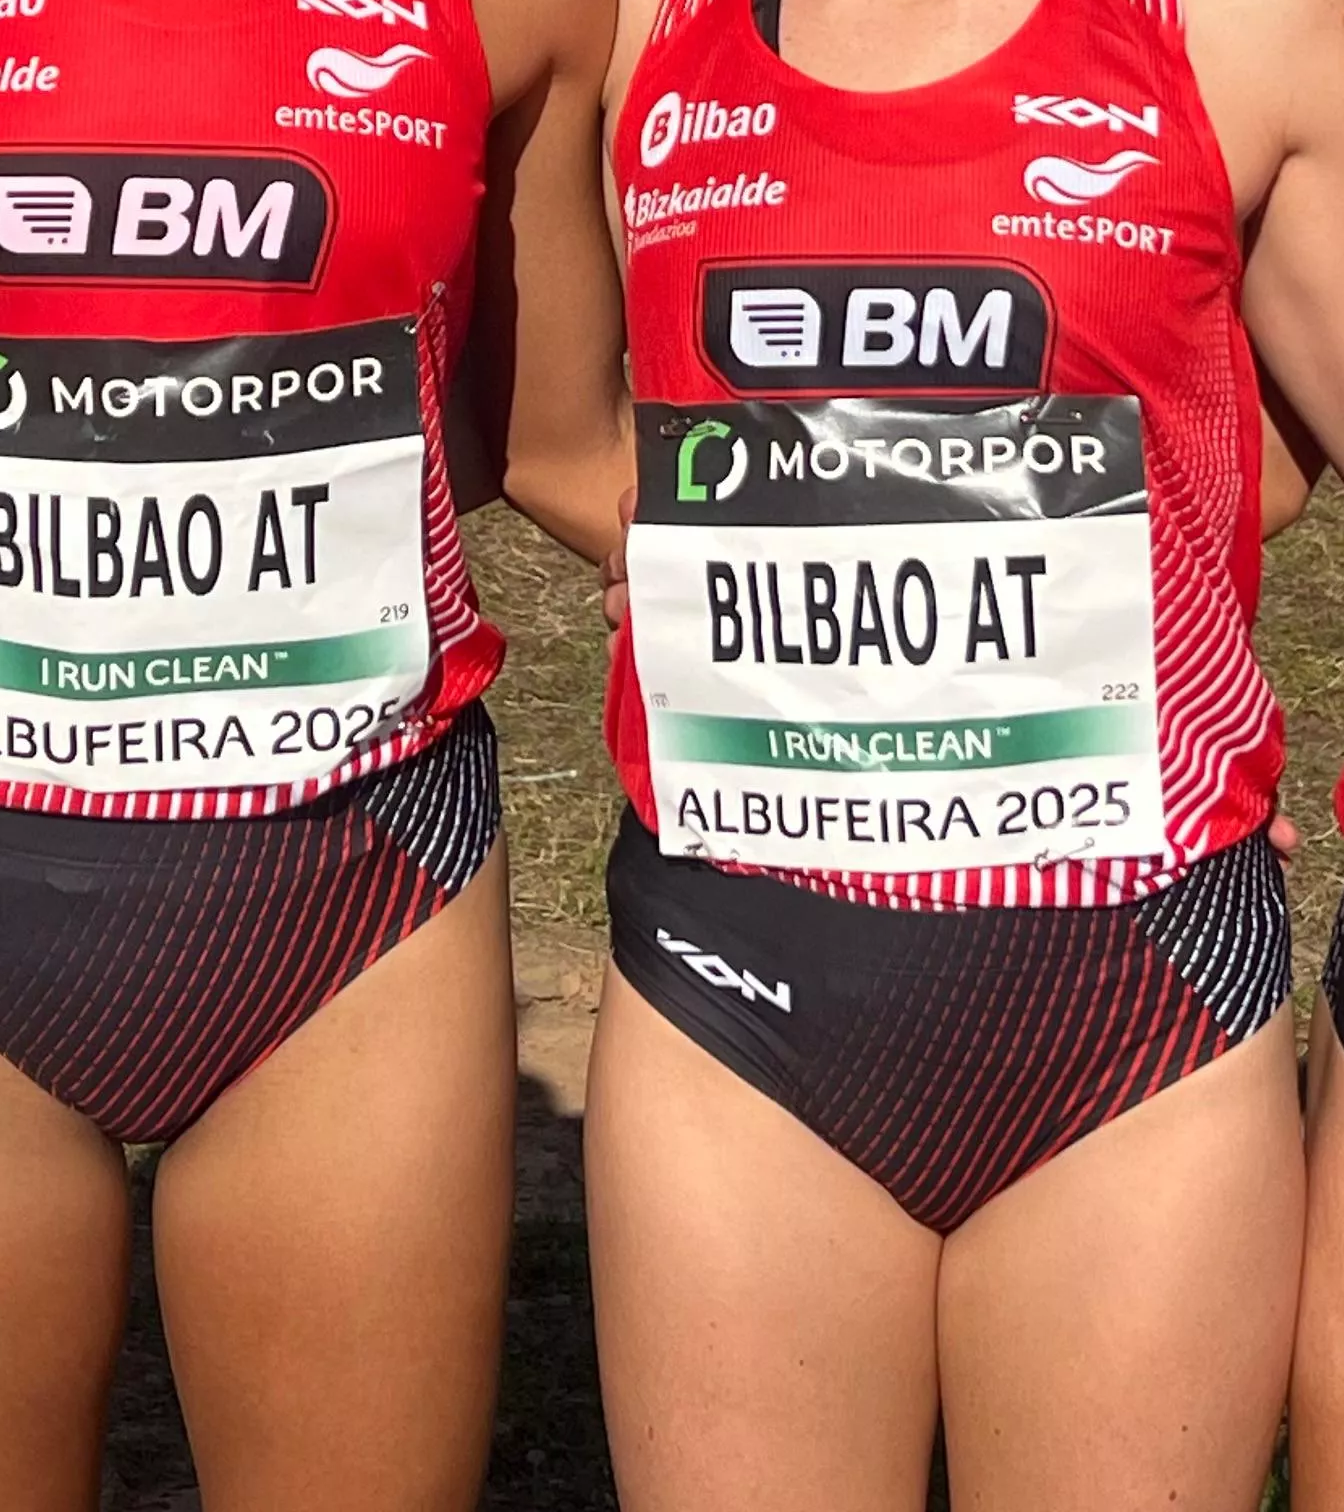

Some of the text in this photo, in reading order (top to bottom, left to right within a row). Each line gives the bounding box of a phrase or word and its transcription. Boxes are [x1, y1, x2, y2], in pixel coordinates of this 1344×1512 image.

[275, 104, 448, 150] emteSPORT
[640, 91, 777, 168] Bilbao
[112, 176, 294, 261] BM
[635, 172, 787, 228] Bizkaialde
[991, 211, 1175, 256] emteSPORT
[842, 287, 1013, 369] BM
[50, 356, 384, 419] MOTORPOR
[767, 434, 1106, 481] MOTORPOR
[247, 482, 331, 593] AT
[379, 603, 409, 624] 219
[705, 553, 1047, 666] BILBAO AT
[41, 657, 49, 686] I
[57, 658, 136, 692] RUN
[1101, 683, 1140, 701] 222
[767, 729, 779, 759] I
[785, 729, 858, 761] RUN
[676, 780, 1131, 844] ALBUFEIRA 2025
